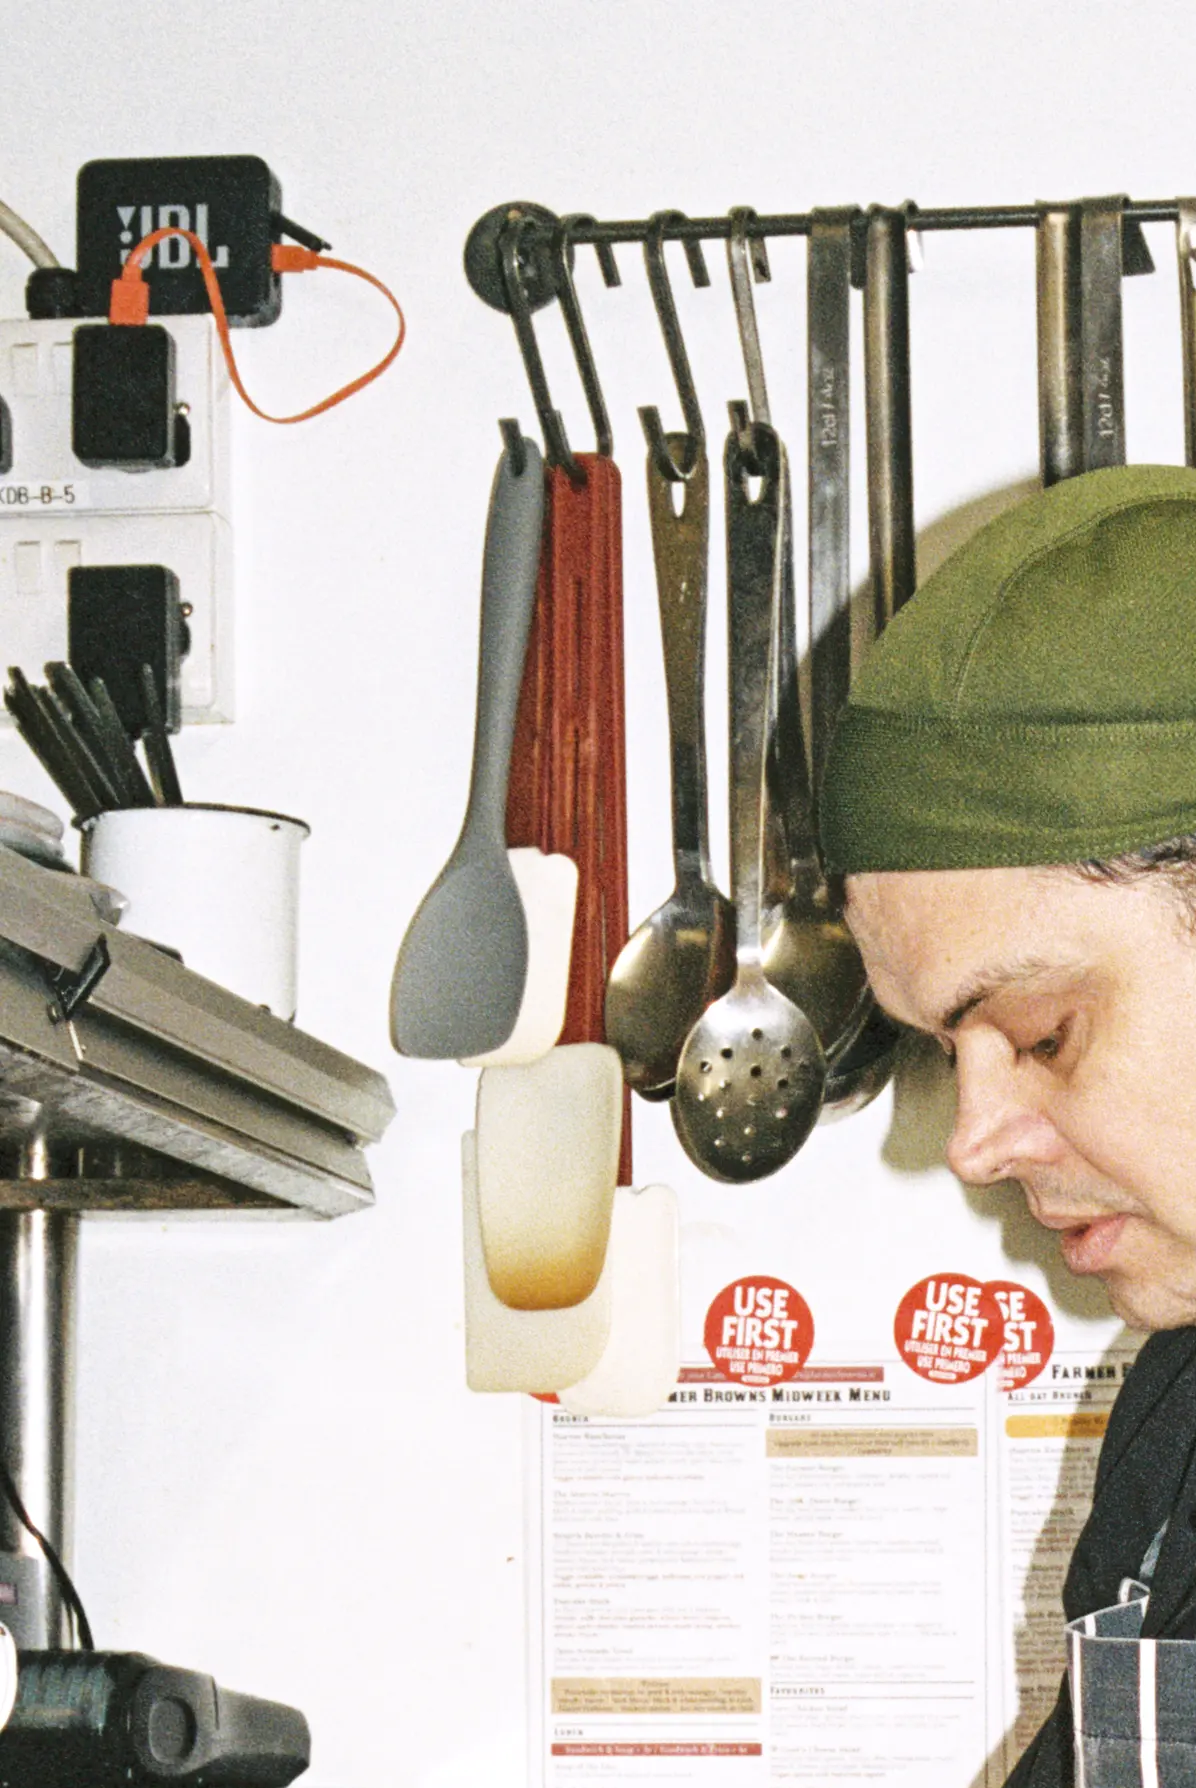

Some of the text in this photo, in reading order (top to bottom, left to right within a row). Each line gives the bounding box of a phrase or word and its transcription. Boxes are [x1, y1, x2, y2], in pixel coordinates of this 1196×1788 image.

[117, 204, 229, 269] JBL
[734, 1286, 789, 1318] USE
[925, 1280, 982, 1317] USE
[722, 1315, 798, 1349] FIRST
[911, 1310, 989, 1348] FIRST
